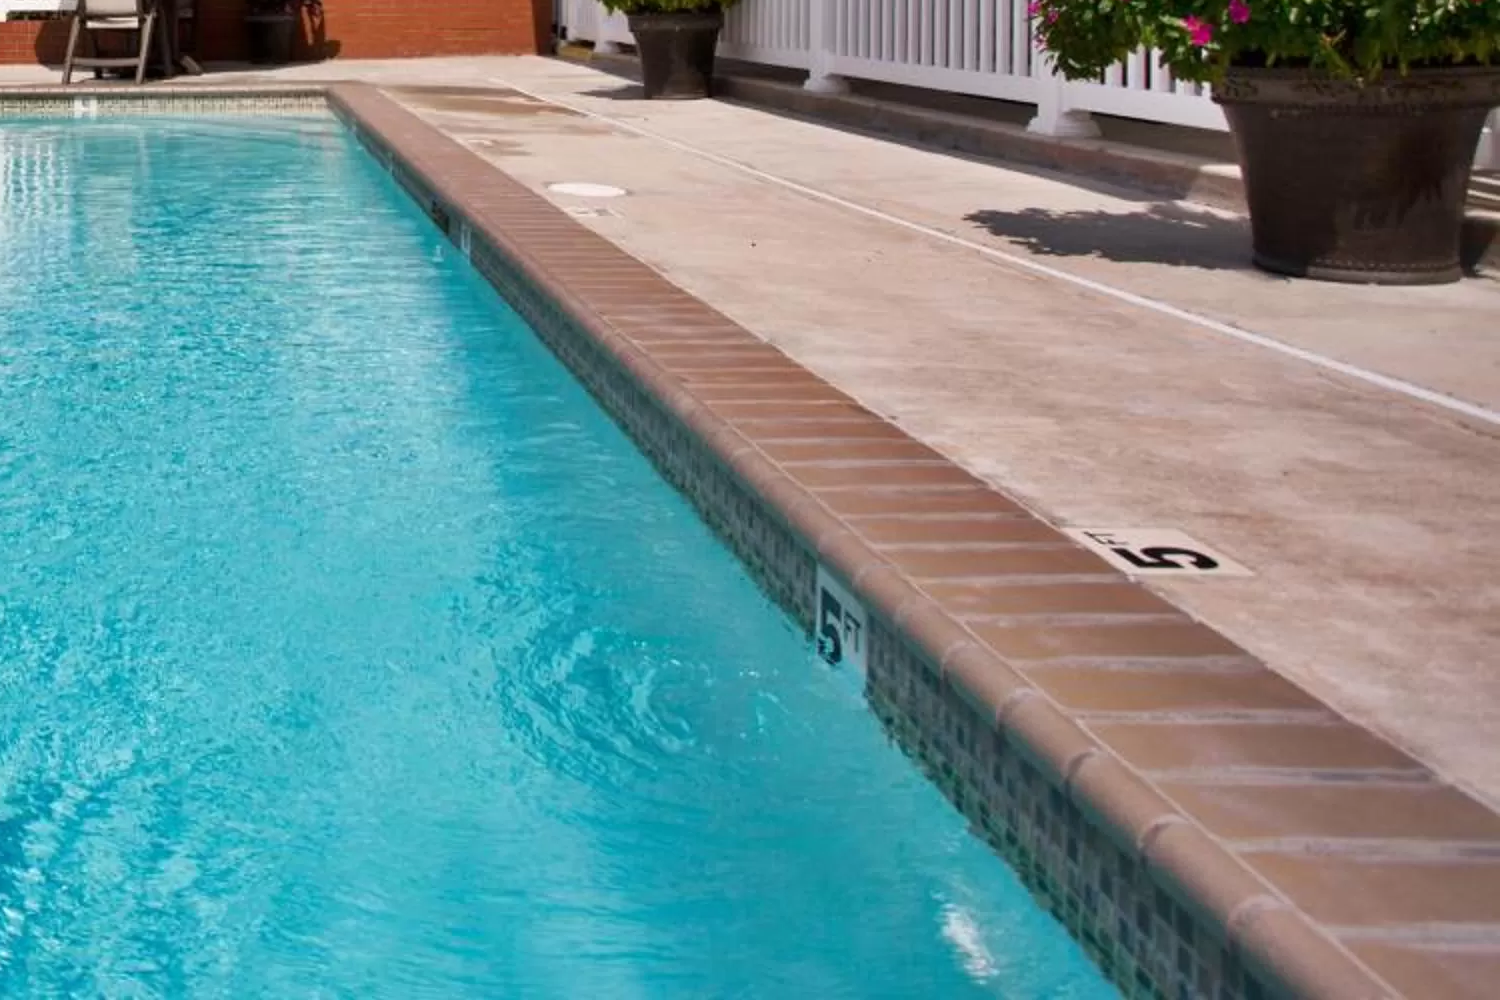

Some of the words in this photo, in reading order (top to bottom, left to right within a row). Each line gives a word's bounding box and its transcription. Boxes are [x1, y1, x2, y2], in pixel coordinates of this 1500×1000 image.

[1110, 546, 1219, 569] 5
[817, 585, 843, 666] 5
[843, 607, 861, 653] FT
